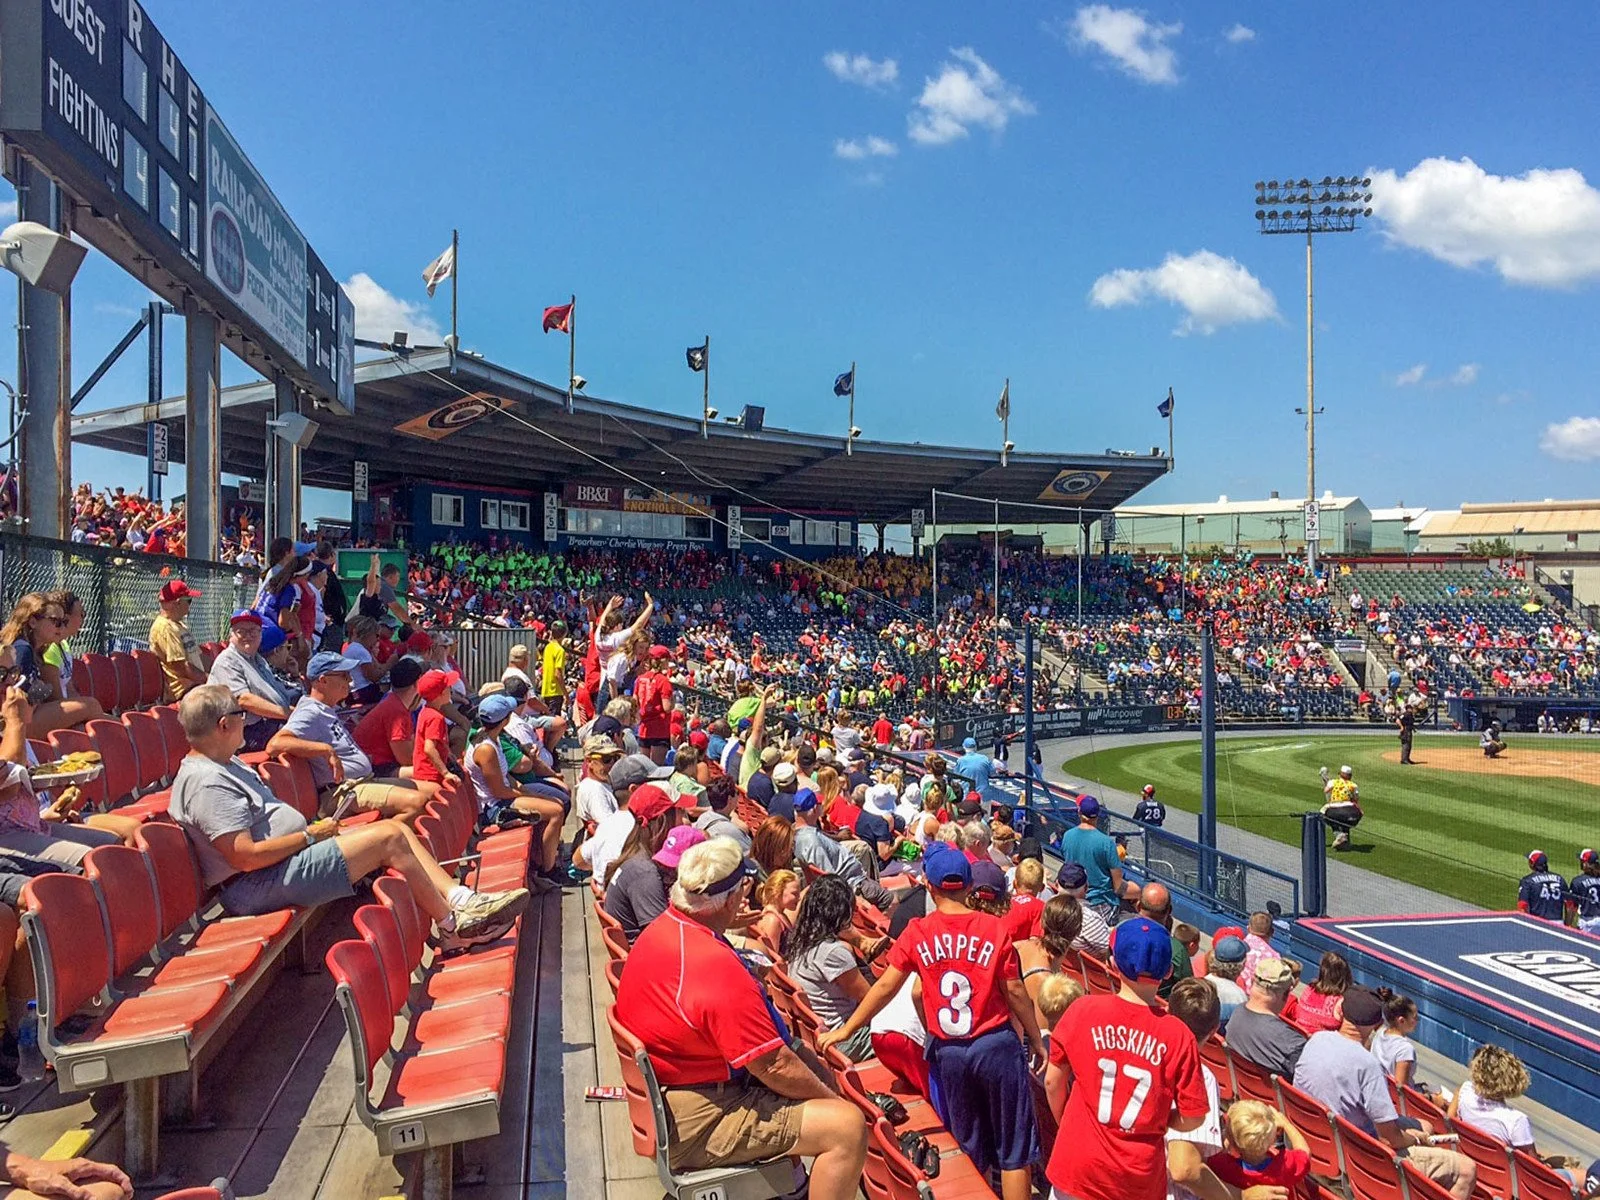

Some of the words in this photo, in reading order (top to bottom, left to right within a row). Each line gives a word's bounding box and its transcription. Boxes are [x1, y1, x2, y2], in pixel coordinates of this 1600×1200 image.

[128, 0, 142, 53] R
[162, 40, 175, 96] H
[187, 76, 198, 125] E
[49, 56, 118, 169] FIGHTINS
[211, 144, 272, 252] RAILROAD
[161, 428, 167, 441] 2
[160, 446, 166, 460] 3
[361, 464, 366, 475] 3
[577, 485, 612, 502] BB&T
[623, 500, 676, 514] KNOTHOLE
[1310, 504, 1315, 512] 8
[549, 517, 554, 527] 5
[1310, 521, 1315, 529] 9
[1102, 708, 1144, 719] Manpower
[1145, 808, 1160, 820] 28
[1541, 882, 1561, 900] 45
[917, 933, 994, 967] HARPER
[938, 970, 972, 1037] 3
[1091, 1024, 1167, 1066] HOSKINS
[1098, 1058, 1152, 1130] 17
[399, 1127, 415, 1143] 11
